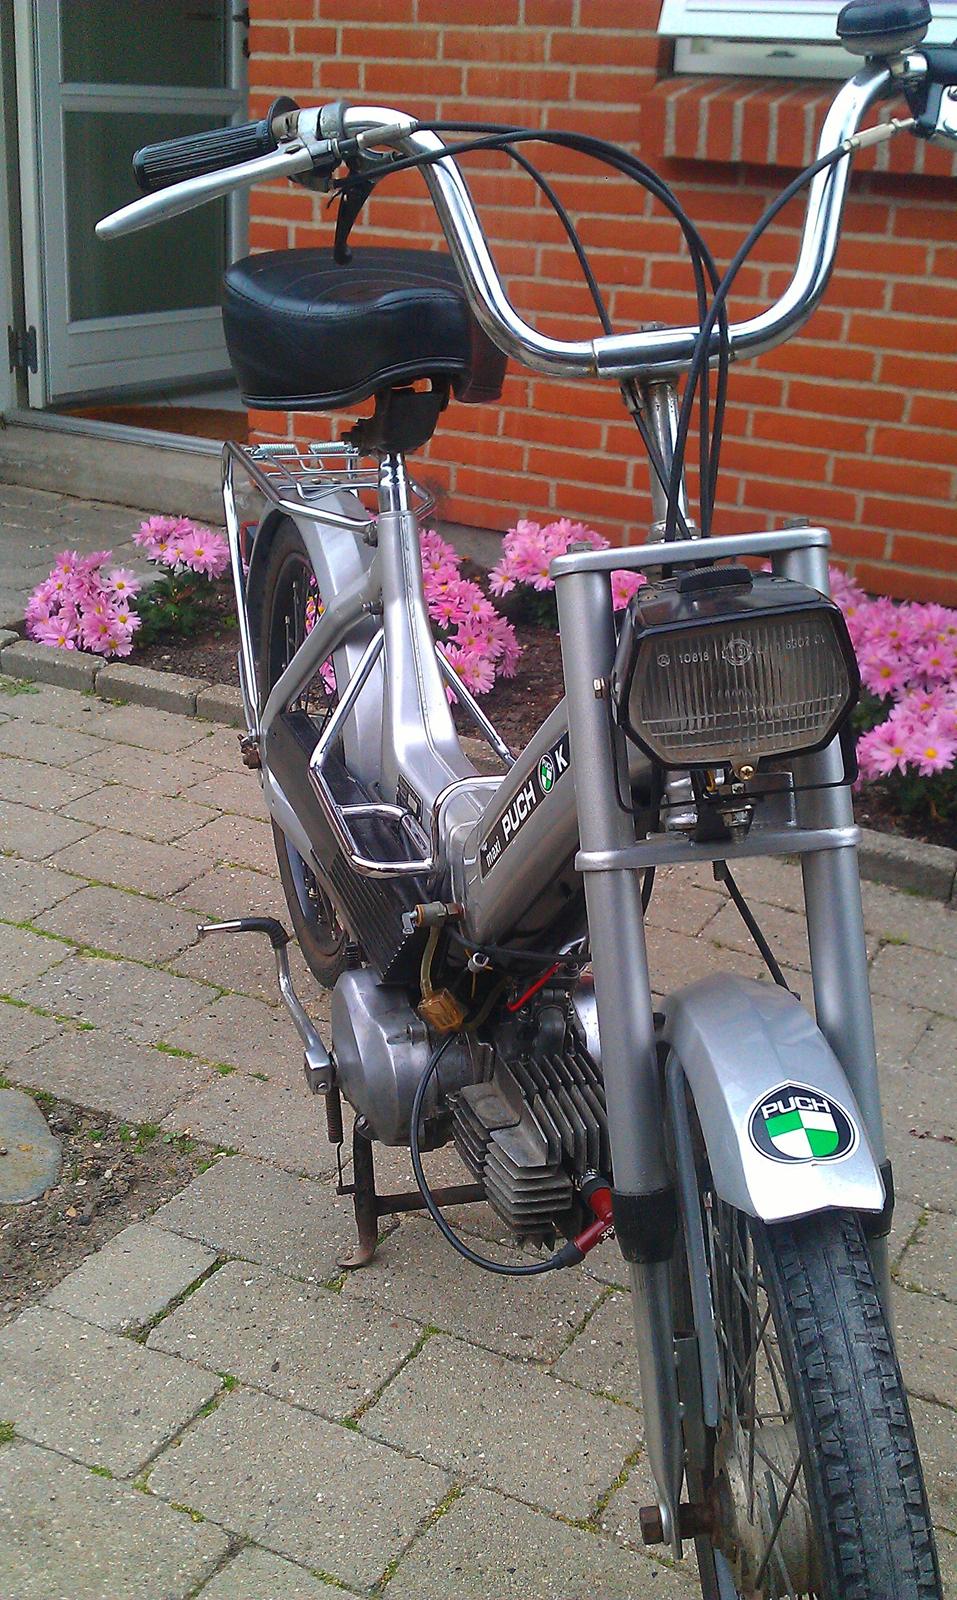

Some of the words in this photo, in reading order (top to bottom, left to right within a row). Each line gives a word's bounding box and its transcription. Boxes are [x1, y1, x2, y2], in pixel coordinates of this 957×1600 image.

[485, 836, 502, 868] maxi
[502, 780, 537, 841] PUCH
[555, 744, 568, 773] K
[761, 1096, 832, 1119] PUCH
